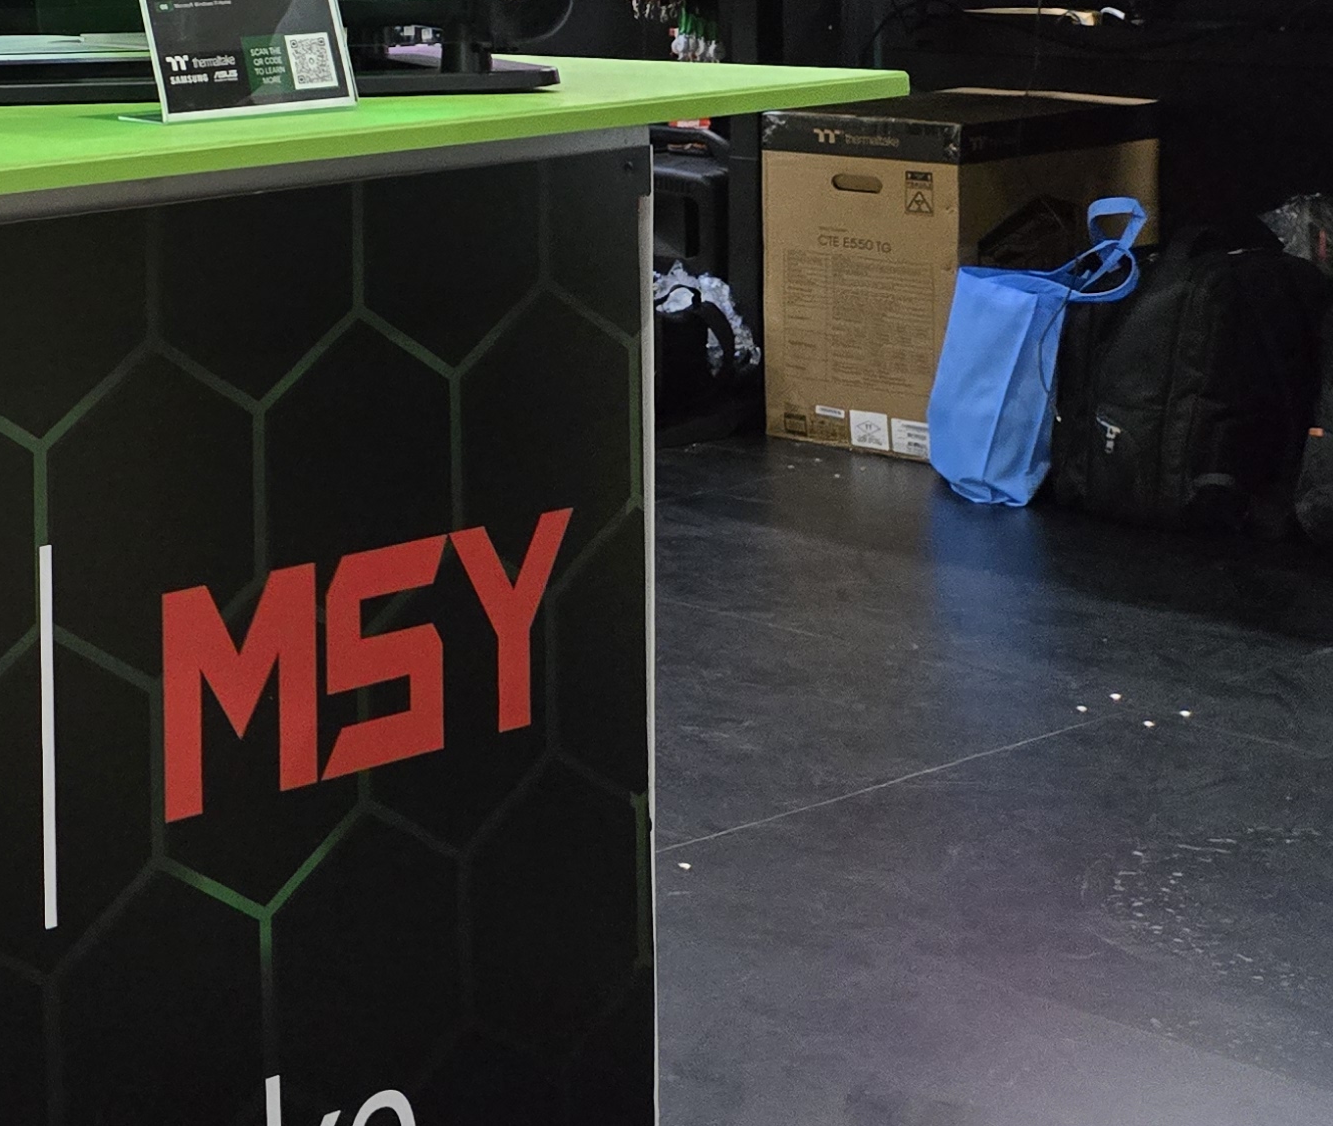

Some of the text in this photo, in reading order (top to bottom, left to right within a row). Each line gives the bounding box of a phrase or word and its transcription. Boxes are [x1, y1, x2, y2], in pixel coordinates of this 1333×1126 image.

[250, 46, 283, 57] SCAN THE
[191, 55, 236, 69] thermaltake
[265, 56, 284, 66] CODE
[254, 66, 286, 76] TO LEARN
[169, 73, 209, 85] SAMSUNG
[261, 75, 283, 85] MORE
[844, 132, 900, 148] thermaltake
[817, 233, 893, 255] CTE E550 TG
[164, 510, 570, 820] MSY
